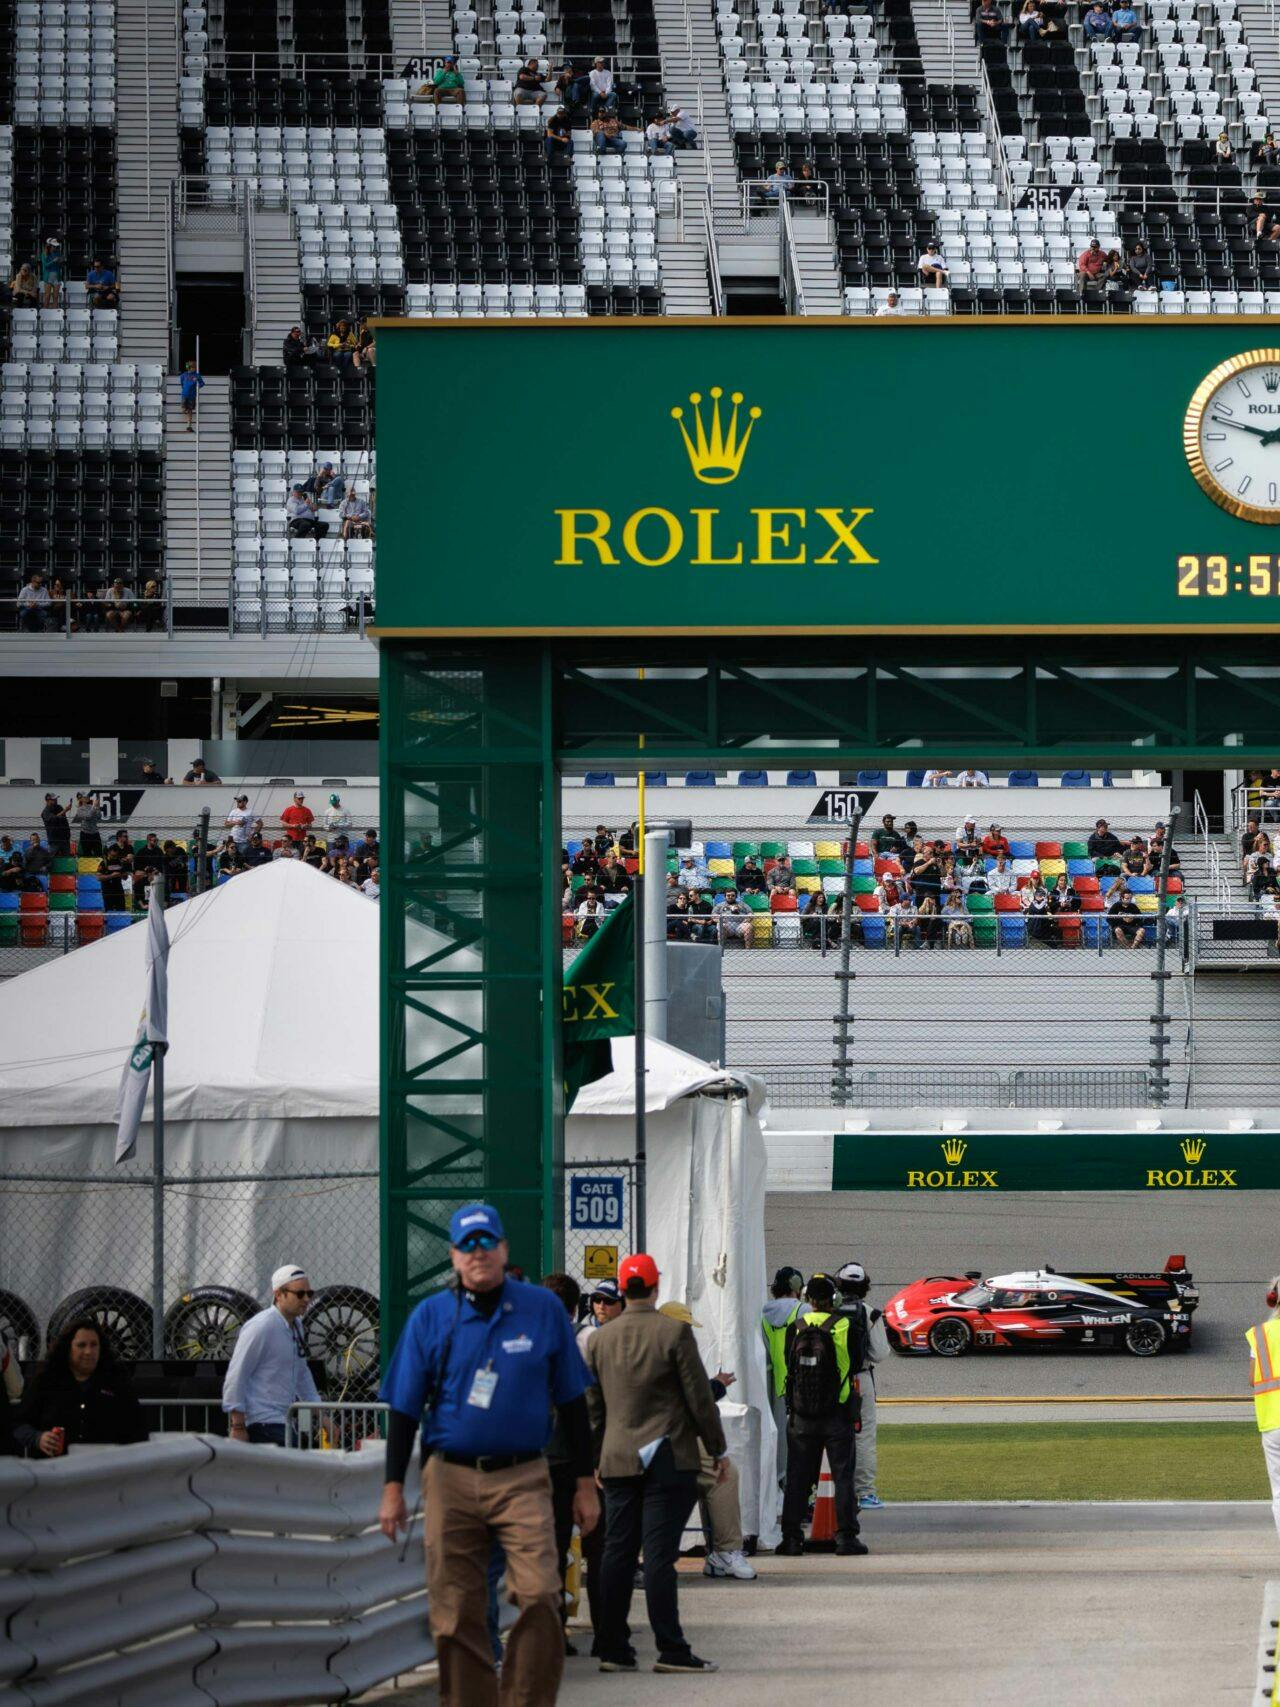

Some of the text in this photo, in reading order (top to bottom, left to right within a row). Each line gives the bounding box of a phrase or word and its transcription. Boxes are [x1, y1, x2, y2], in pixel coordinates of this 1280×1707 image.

[1027, 188, 1061, 211] 355
[554, 506, 880, 567] ROLEX
[90, 792, 121, 820] 51
[825, 793, 860, 822] 150
[907, 1170, 999, 1188] ROLEX
[1146, 1169, 1238, 1187] ROLEX
[581, 1183, 614, 1195] GATE
[575, 1197, 619, 1223] 509
[1081, 1313, 1132, 1325] WHELEN
[979, 1333, 994, 1345] 31
